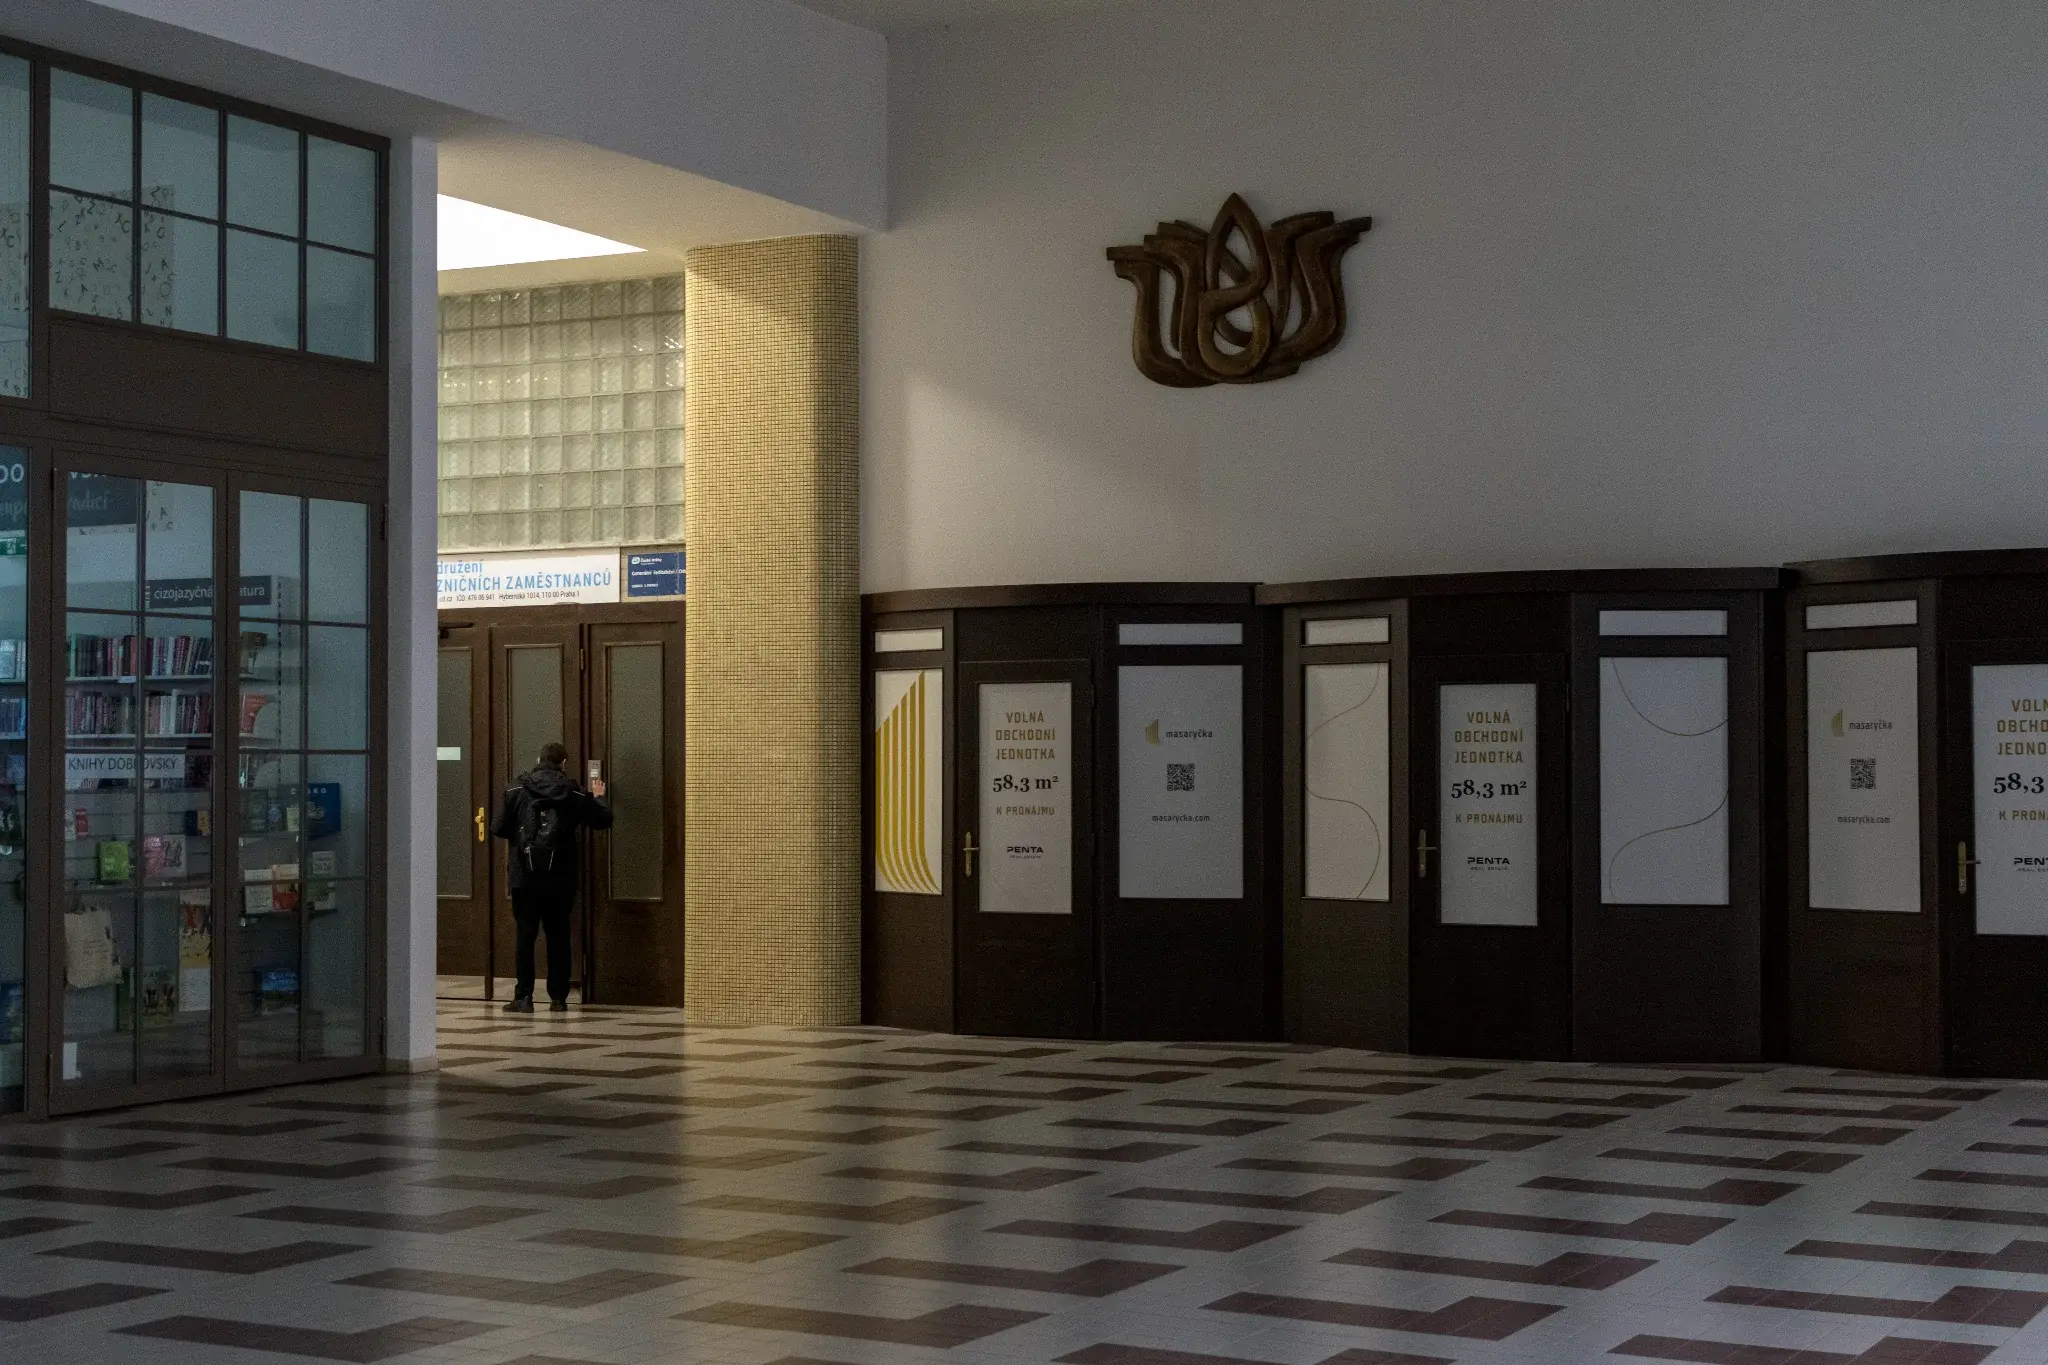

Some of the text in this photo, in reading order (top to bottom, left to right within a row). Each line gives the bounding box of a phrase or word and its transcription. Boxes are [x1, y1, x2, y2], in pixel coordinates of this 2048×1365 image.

[506, 567, 611, 590] ZAMĚSTNANCŮ
[561, 590, 576, 598] Praha
[1006, 711, 1045, 723] VOLNÁ
[1467, 710, 1510, 724] VOLNÁ
[1849, 720, 1892, 731] masaryčka
[995, 728, 1056, 741] OBCHODNÍ
[1166, 729, 1213, 741] masaryčka
[1454, 728, 1523, 743] OBCHODNÍ
[996, 749, 1056, 760] JEDNOTKA
[1455, 751, 1523, 763] JEDNOTKA
[68, 757, 106, 771] KNIHY
[992, 774, 1030, 793] 58,3
[1451, 779, 1494, 799] 58,3
[1993, 773, 2045, 794] 58,3
[1467, 857, 1510, 865] PENTA
